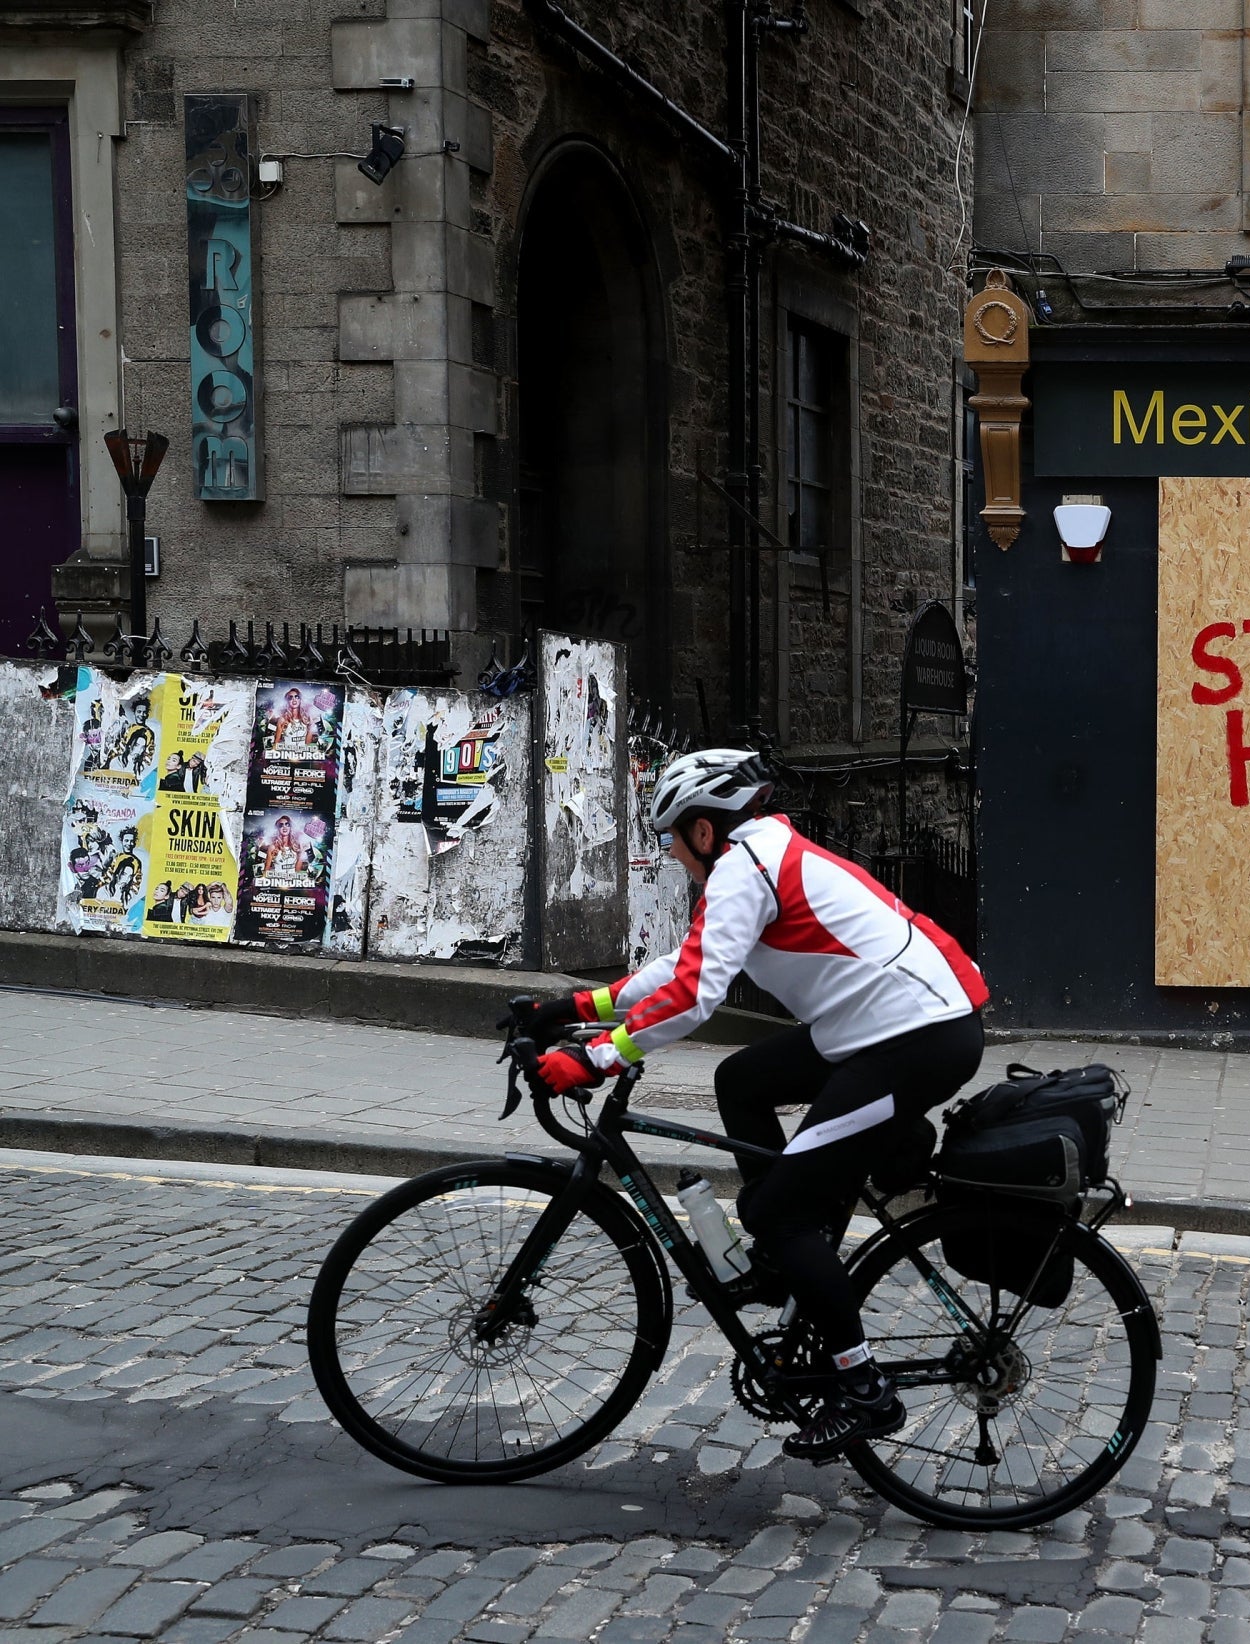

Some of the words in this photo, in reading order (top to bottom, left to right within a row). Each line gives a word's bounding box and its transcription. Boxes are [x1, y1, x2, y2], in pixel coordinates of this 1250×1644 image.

[916, 666, 955, 689] WAREHOUSE
[264, 750, 326, 760] EDINBURGH
[446, 742, 494, 773] 90'S
[112, 777, 139, 786] FRIDAY
[169, 838, 224, 855] THURSDAYS
[254, 878, 316, 888] EDINBURGH
[100, 907, 128, 916] FRIDAY
